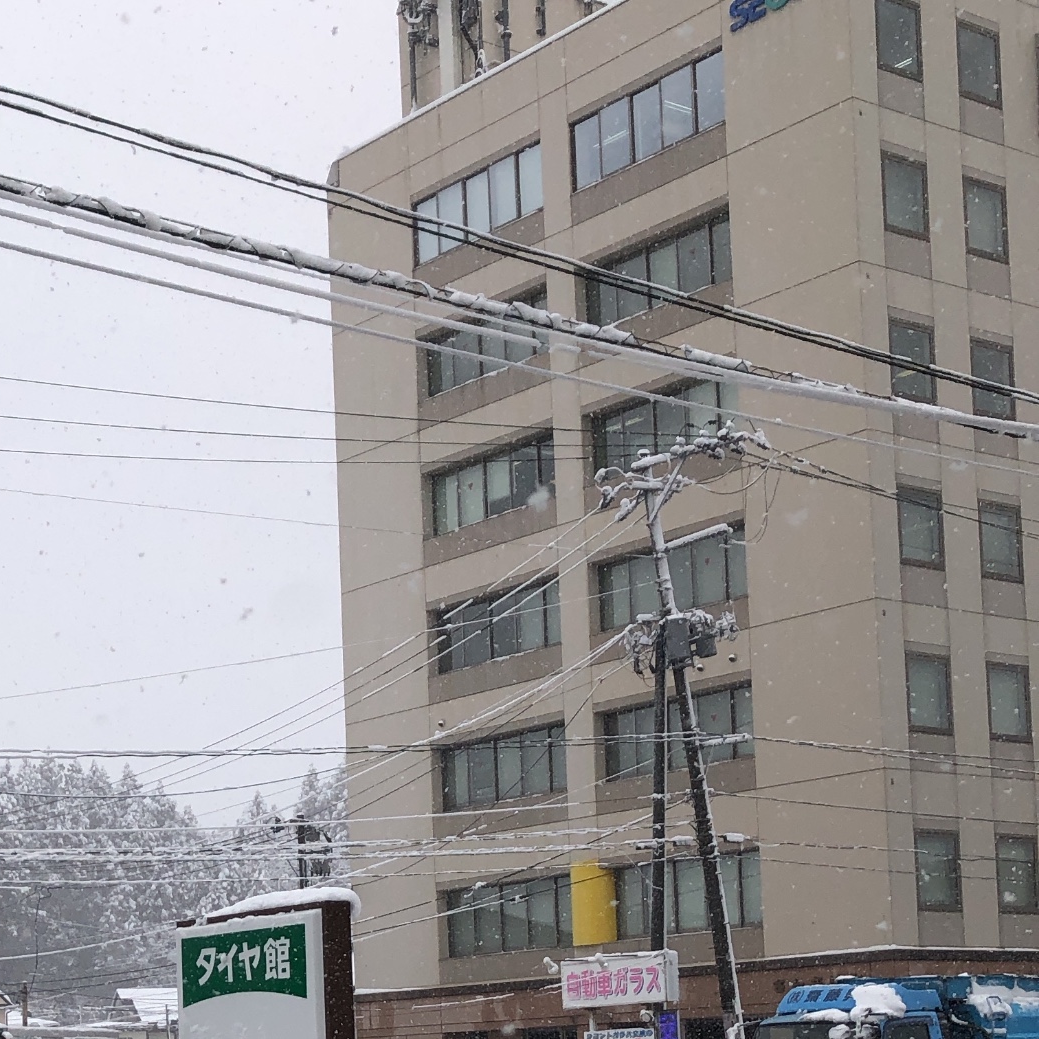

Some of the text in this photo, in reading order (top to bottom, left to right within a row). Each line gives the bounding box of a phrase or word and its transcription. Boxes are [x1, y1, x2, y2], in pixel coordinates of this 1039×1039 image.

[195, 936, 291, 986] タイヤ館
[566, 966, 661, 1000] 自動車ガラス
